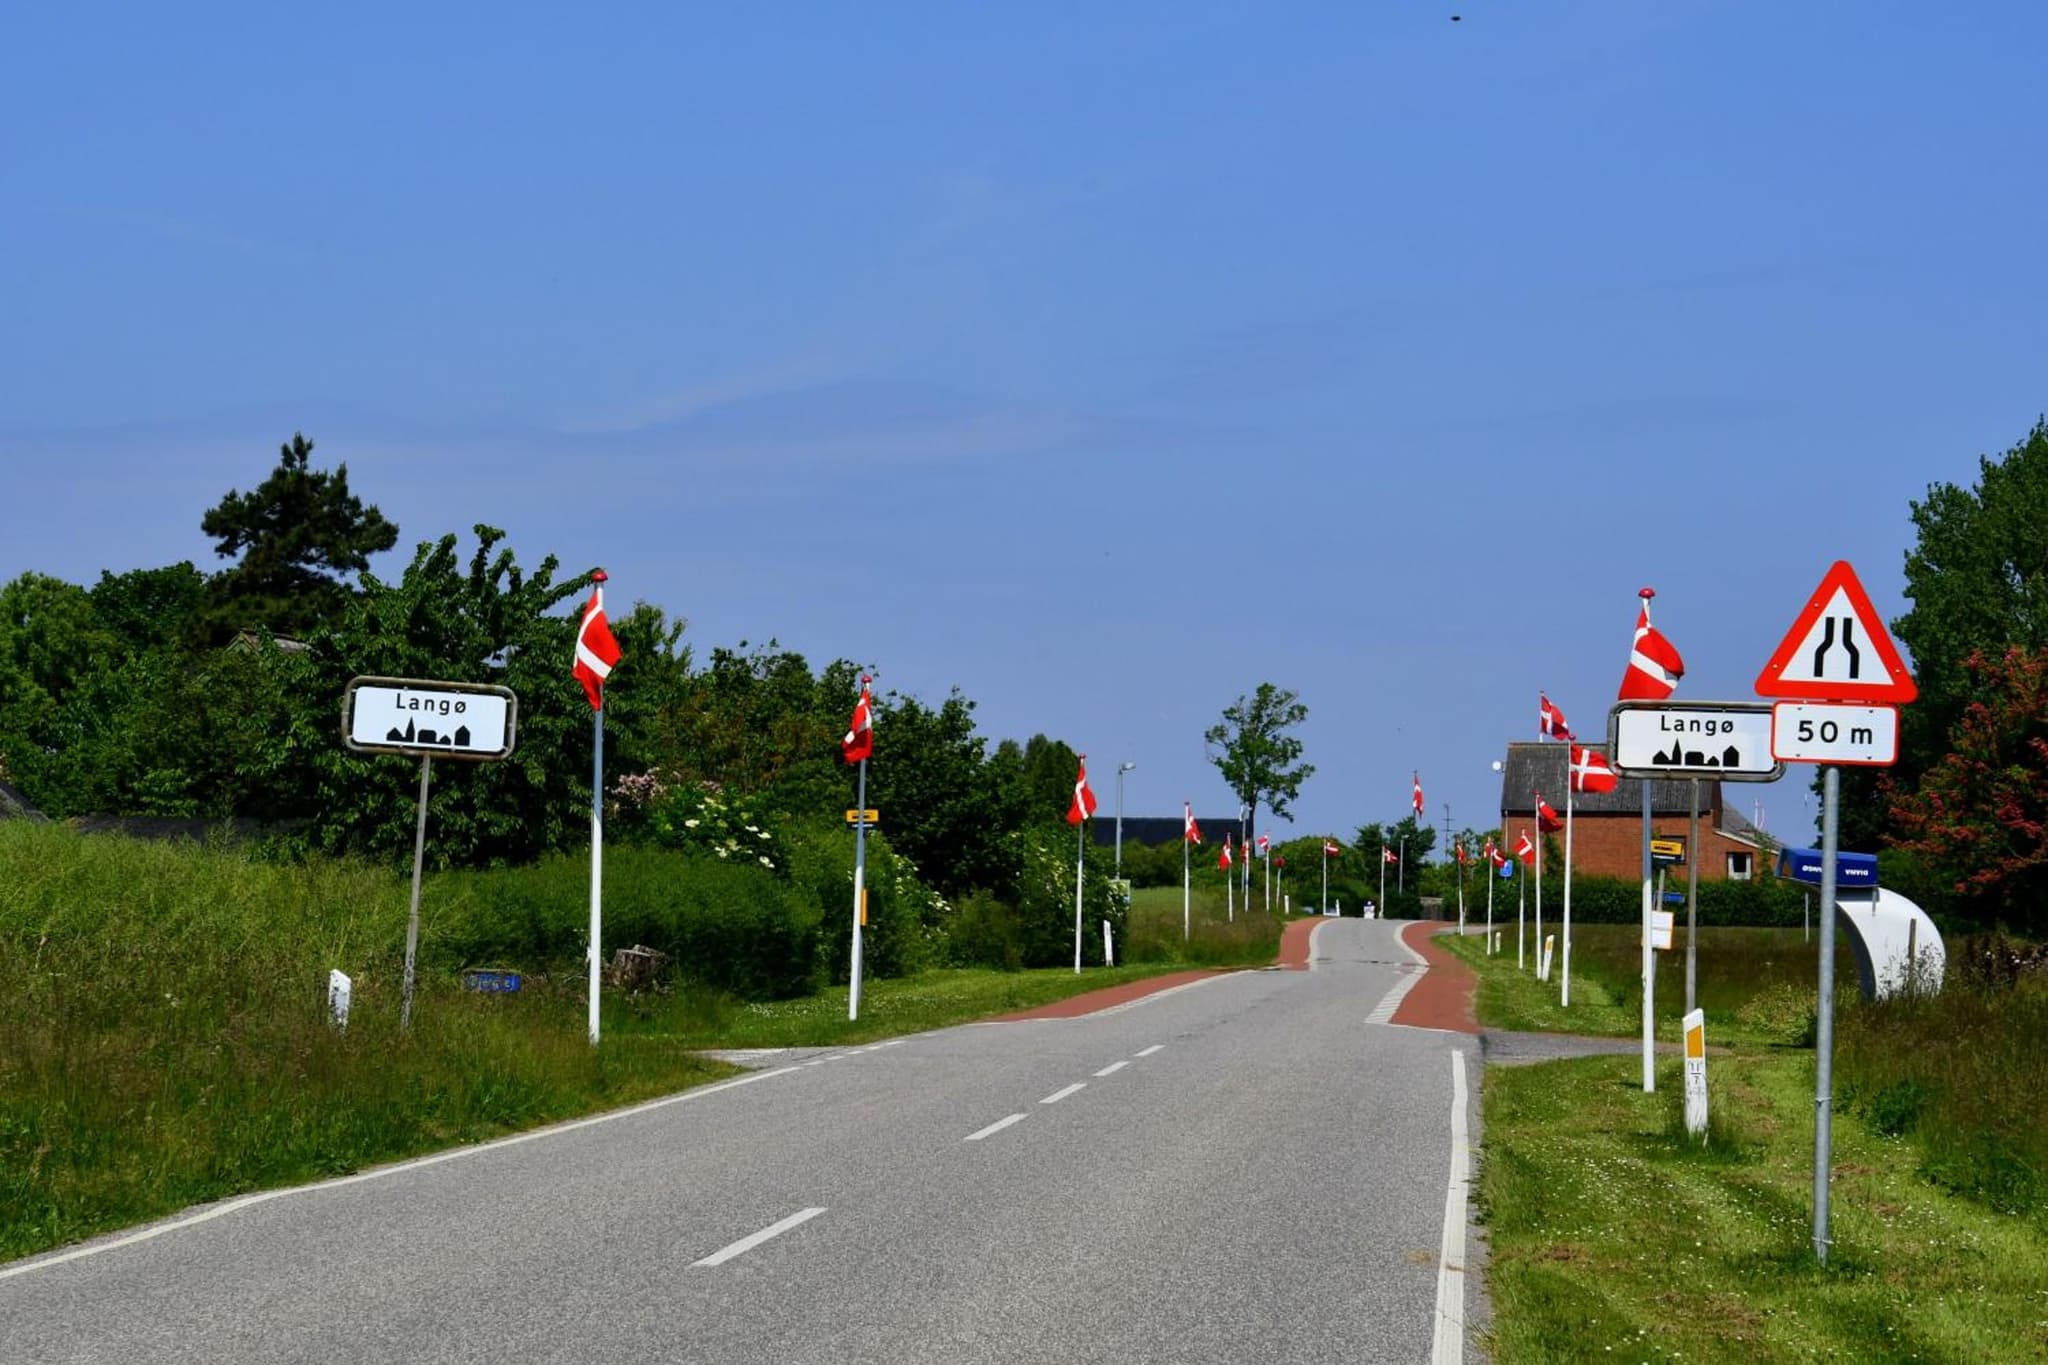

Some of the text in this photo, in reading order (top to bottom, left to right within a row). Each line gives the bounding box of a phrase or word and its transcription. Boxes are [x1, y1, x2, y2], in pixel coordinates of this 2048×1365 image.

[396, 692, 466, 716] Langø
[1661, 714, 1734, 737] Langø
[1797, 720, 1872, 745] 50 m
